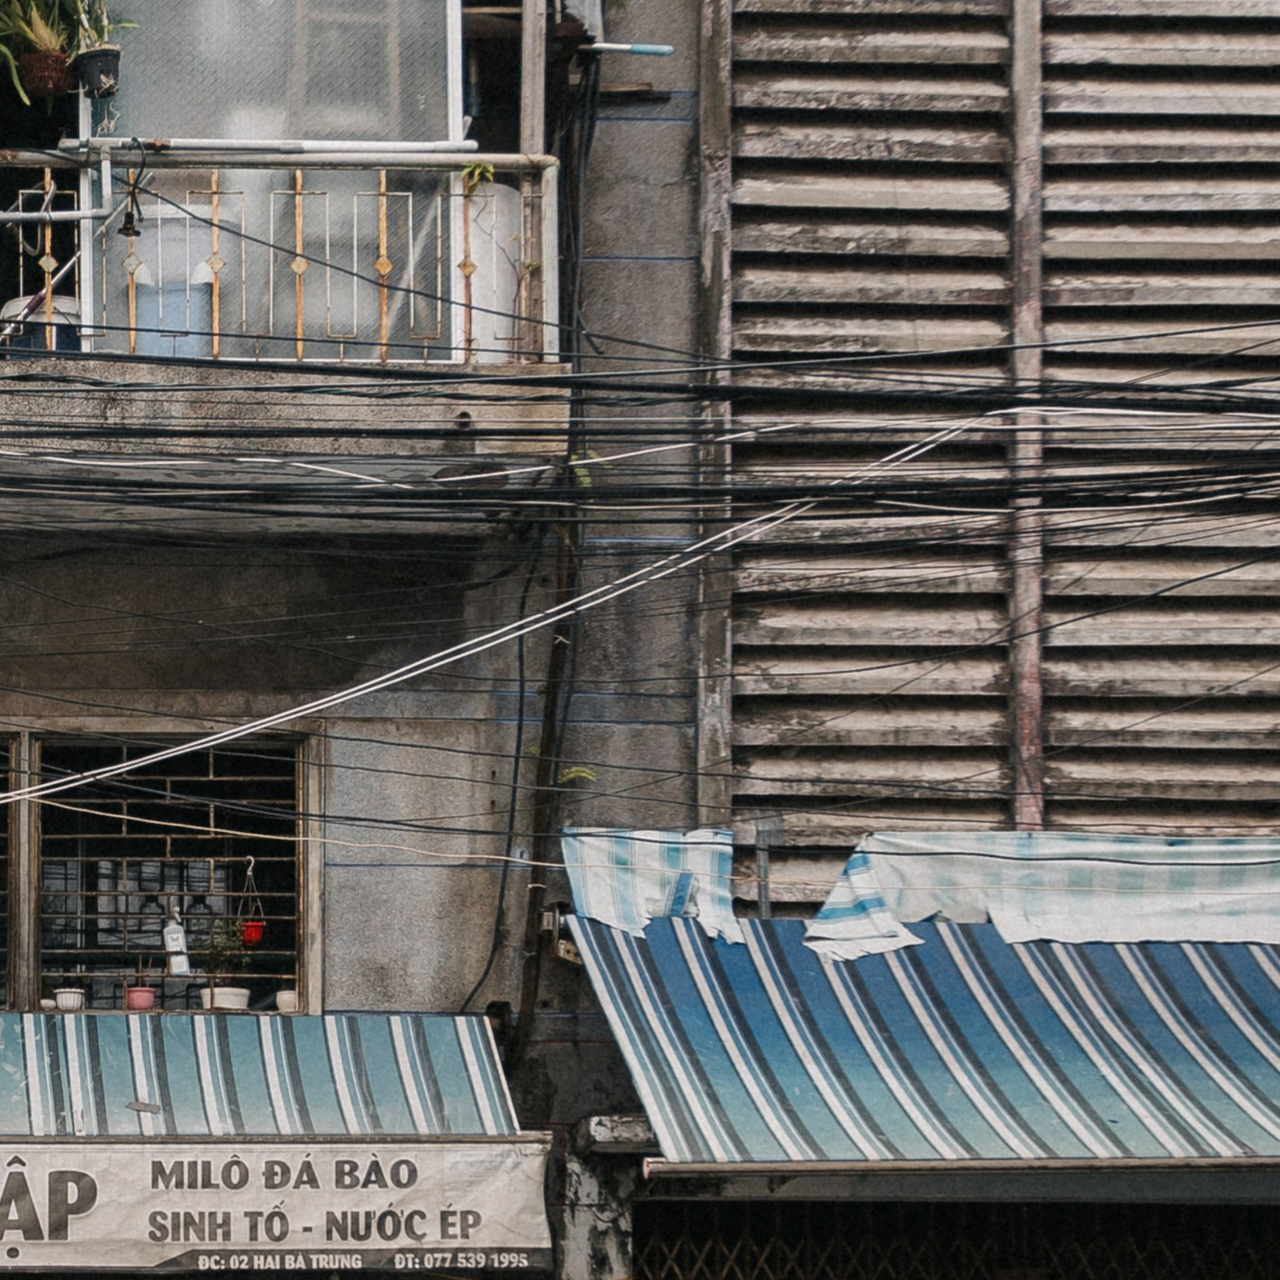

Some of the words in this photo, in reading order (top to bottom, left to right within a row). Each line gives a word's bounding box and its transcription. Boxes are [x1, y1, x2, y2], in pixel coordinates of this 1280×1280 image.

[151, 1153, 250, 1190] MILÔ
[261, 1153, 321, 1190] ĐÁ
[334, 1152, 418, 1190] BÀO
[148, 1210, 232, 1243] SINH
[243, 1200, 290, 1243] TỐ
[325, 1203, 427, 1242] NƯỚC
[439, 1203, 482, 1240] ÉP
[198, 1254, 226, 1270] ĐC:
[229, 1254, 250, 1270] 02
[253, 1254, 281, 1270] HAI
[284, 1251, 307, 1270] BÀ
[309, 1253, 363, 1269] TRƯNG
[394, 1253, 420, 1269] ĐT:
[423, 1252, 453, 1269] 077
[456, 1252, 487, 1269] 539
[490, 1252, 529, 1268] 1995
